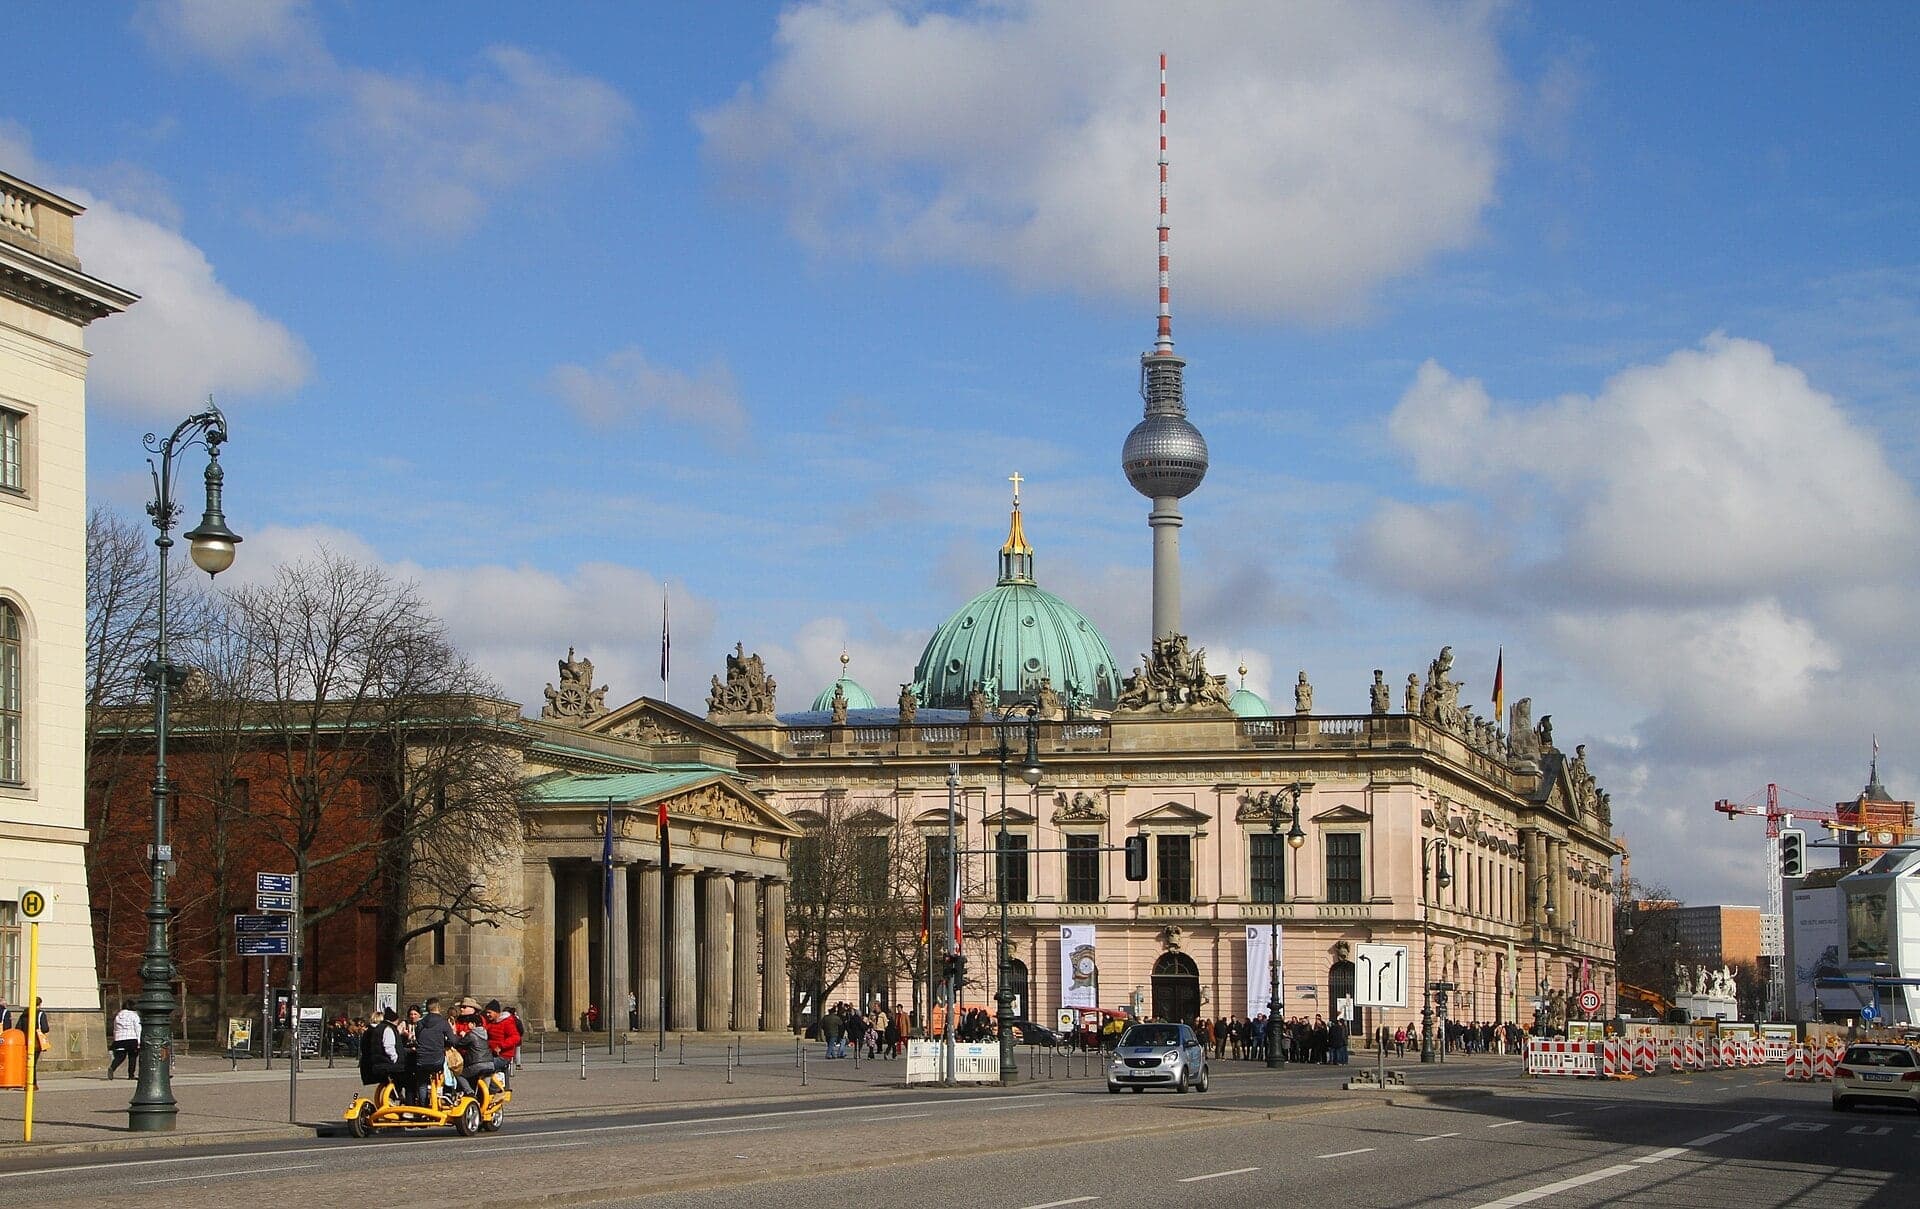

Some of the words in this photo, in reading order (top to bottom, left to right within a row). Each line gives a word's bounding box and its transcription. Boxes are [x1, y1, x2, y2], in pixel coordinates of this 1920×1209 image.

[26, 896, 38, 912] H
[1583, 996, 1596, 1006] 30
[1777, 1122, 1920, 1138] BU
